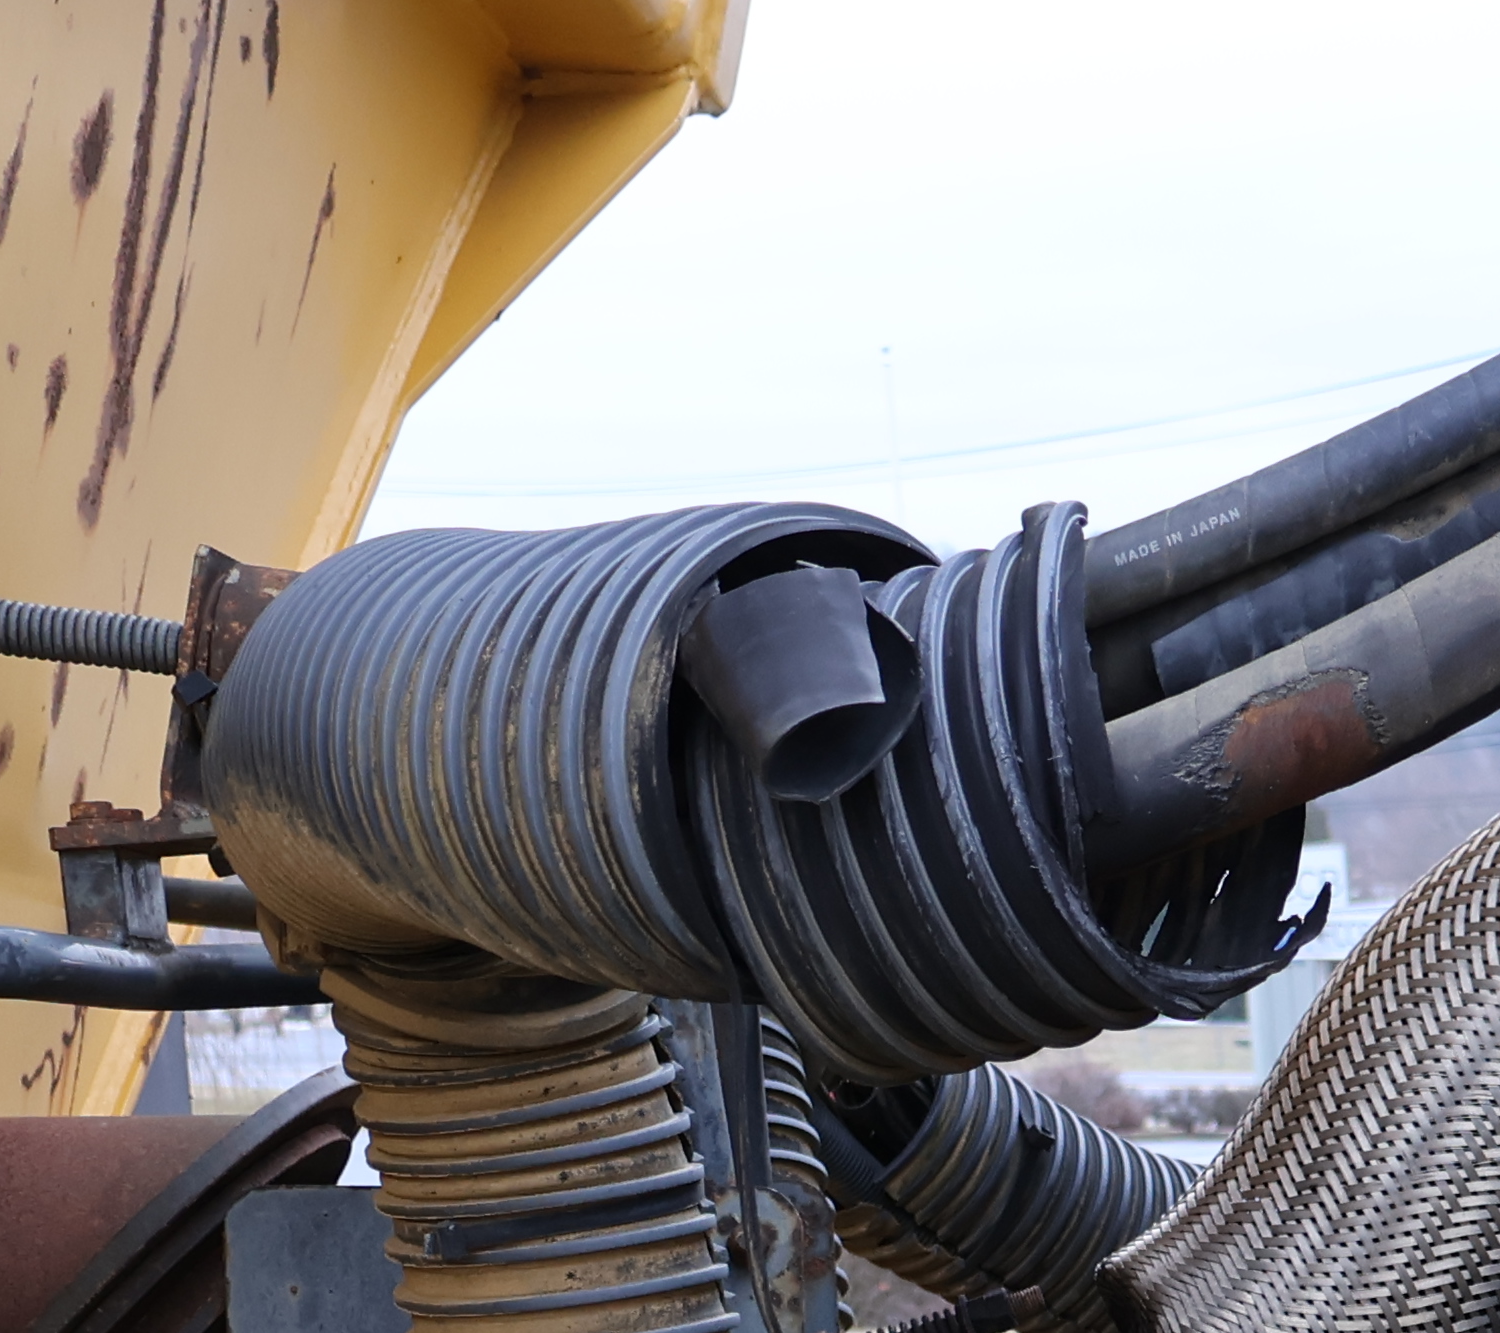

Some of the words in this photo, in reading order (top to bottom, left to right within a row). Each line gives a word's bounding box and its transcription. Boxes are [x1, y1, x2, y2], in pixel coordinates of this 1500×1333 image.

[1114, 540, 1160, 566] MADE
[1165, 531, 1183, 547] IN
[1190, 507, 1240, 537] JAPAN
